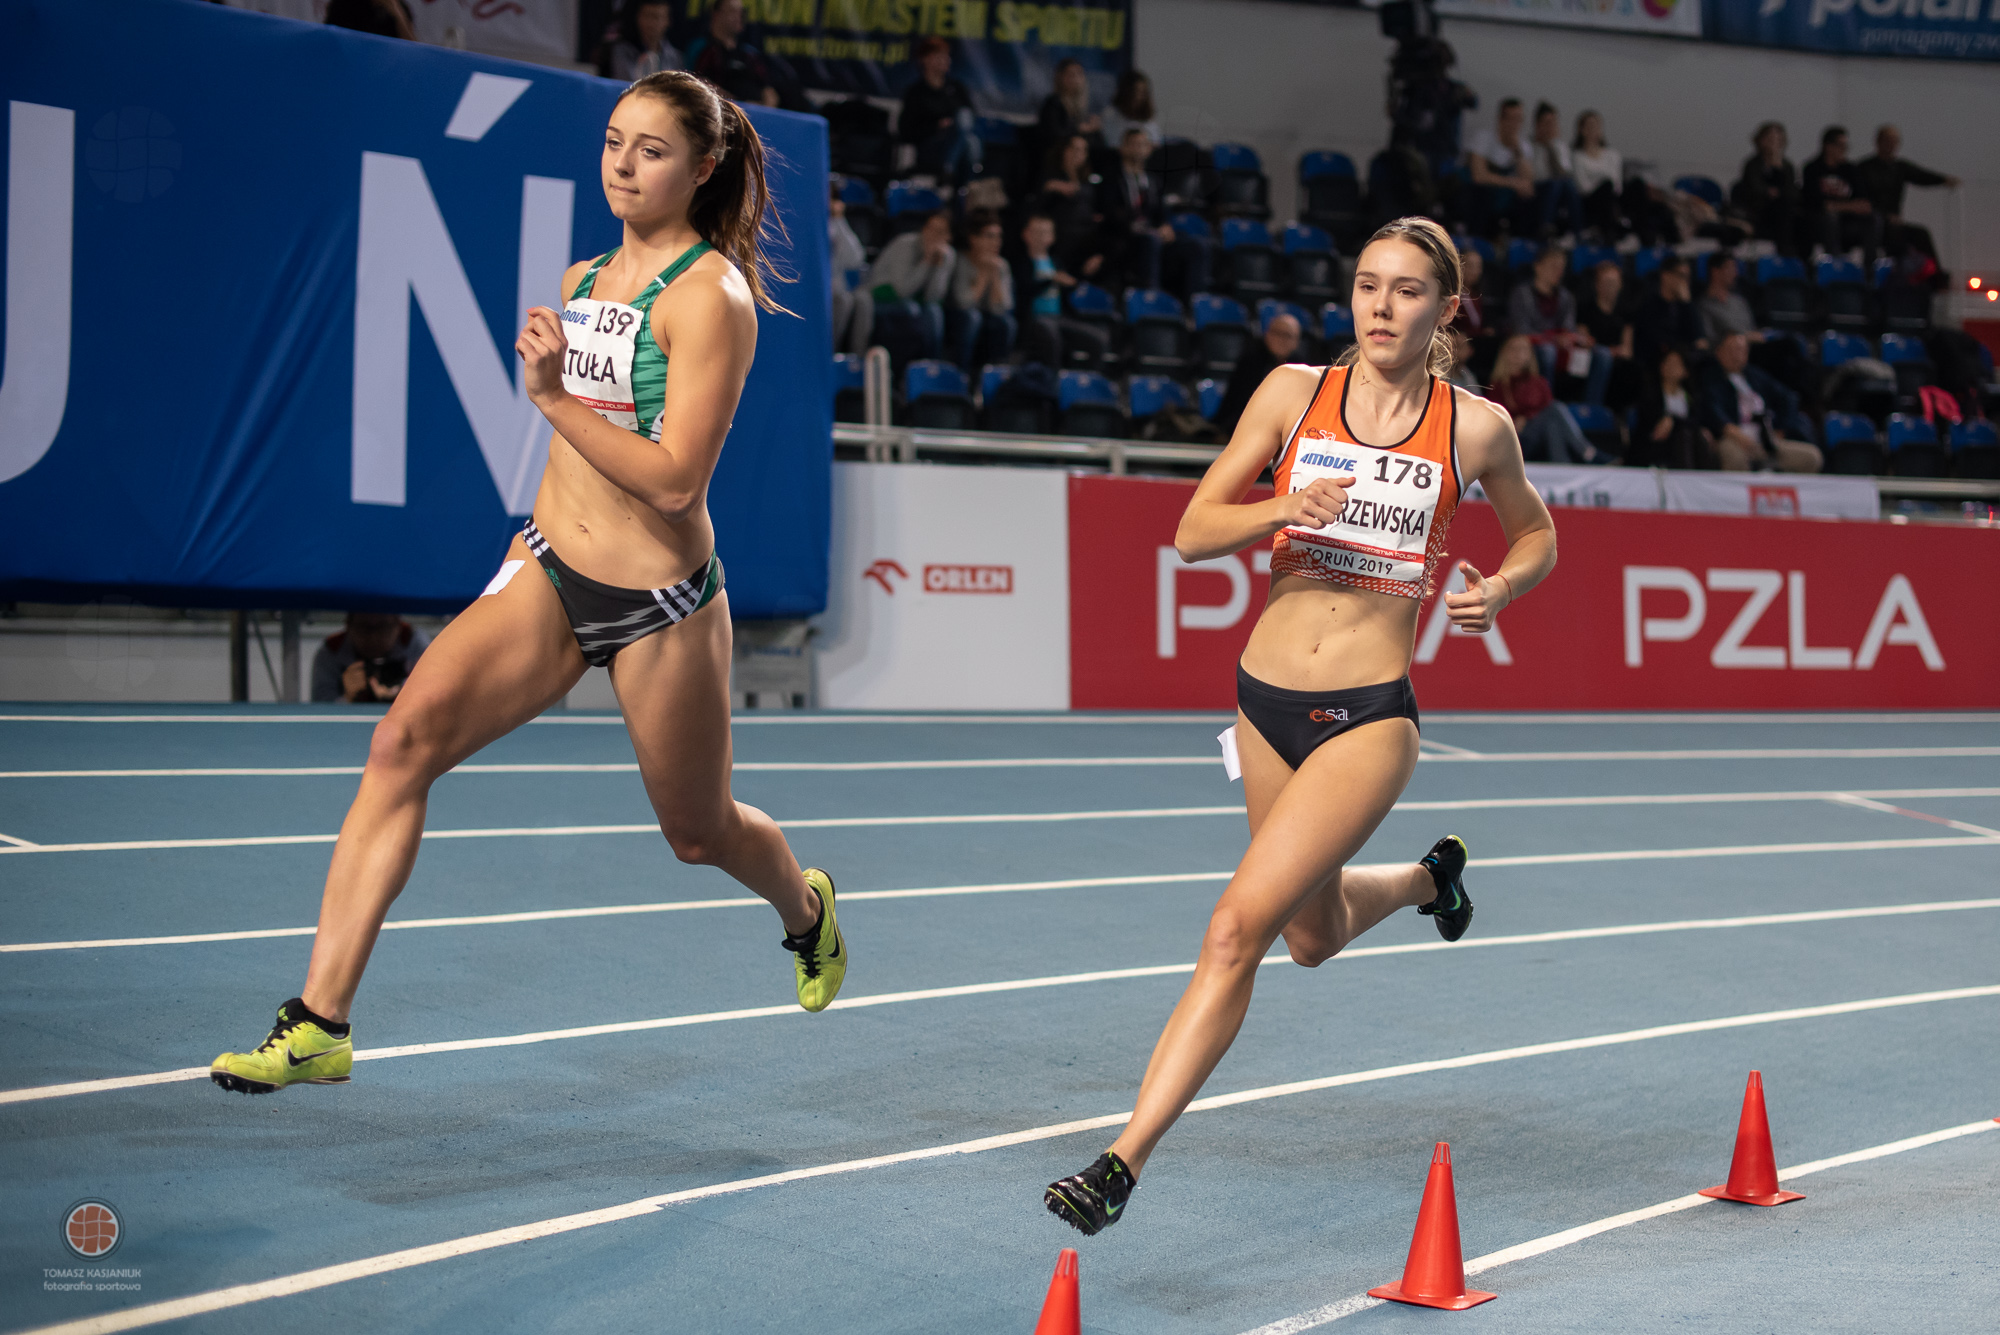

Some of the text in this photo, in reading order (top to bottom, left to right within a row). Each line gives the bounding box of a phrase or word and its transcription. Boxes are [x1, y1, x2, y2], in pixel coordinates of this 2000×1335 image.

[993, 2, 1125, 50] SPORTU
[594, 306, 635, 336] 139
[562, 348, 617, 385] TUŁA
[605, 402, 627, 411] POLSKI
[1300, 452, 1433, 489] 4MOVE 178
[1299, 533, 1316, 543] PZLA
[1316, 537, 1345, 548] HALOWE
[1345, 543, 1394, 557] MISTRZOSTWA
[1395, 551, 1417, 561] POLSKI
[928, 567, 1008, 589] ORLEN
[1357, 557, 1393, 575] 2019
[1156, 545, 1514, 666] PA
[1623, 565, 1947, 671] PZLA
